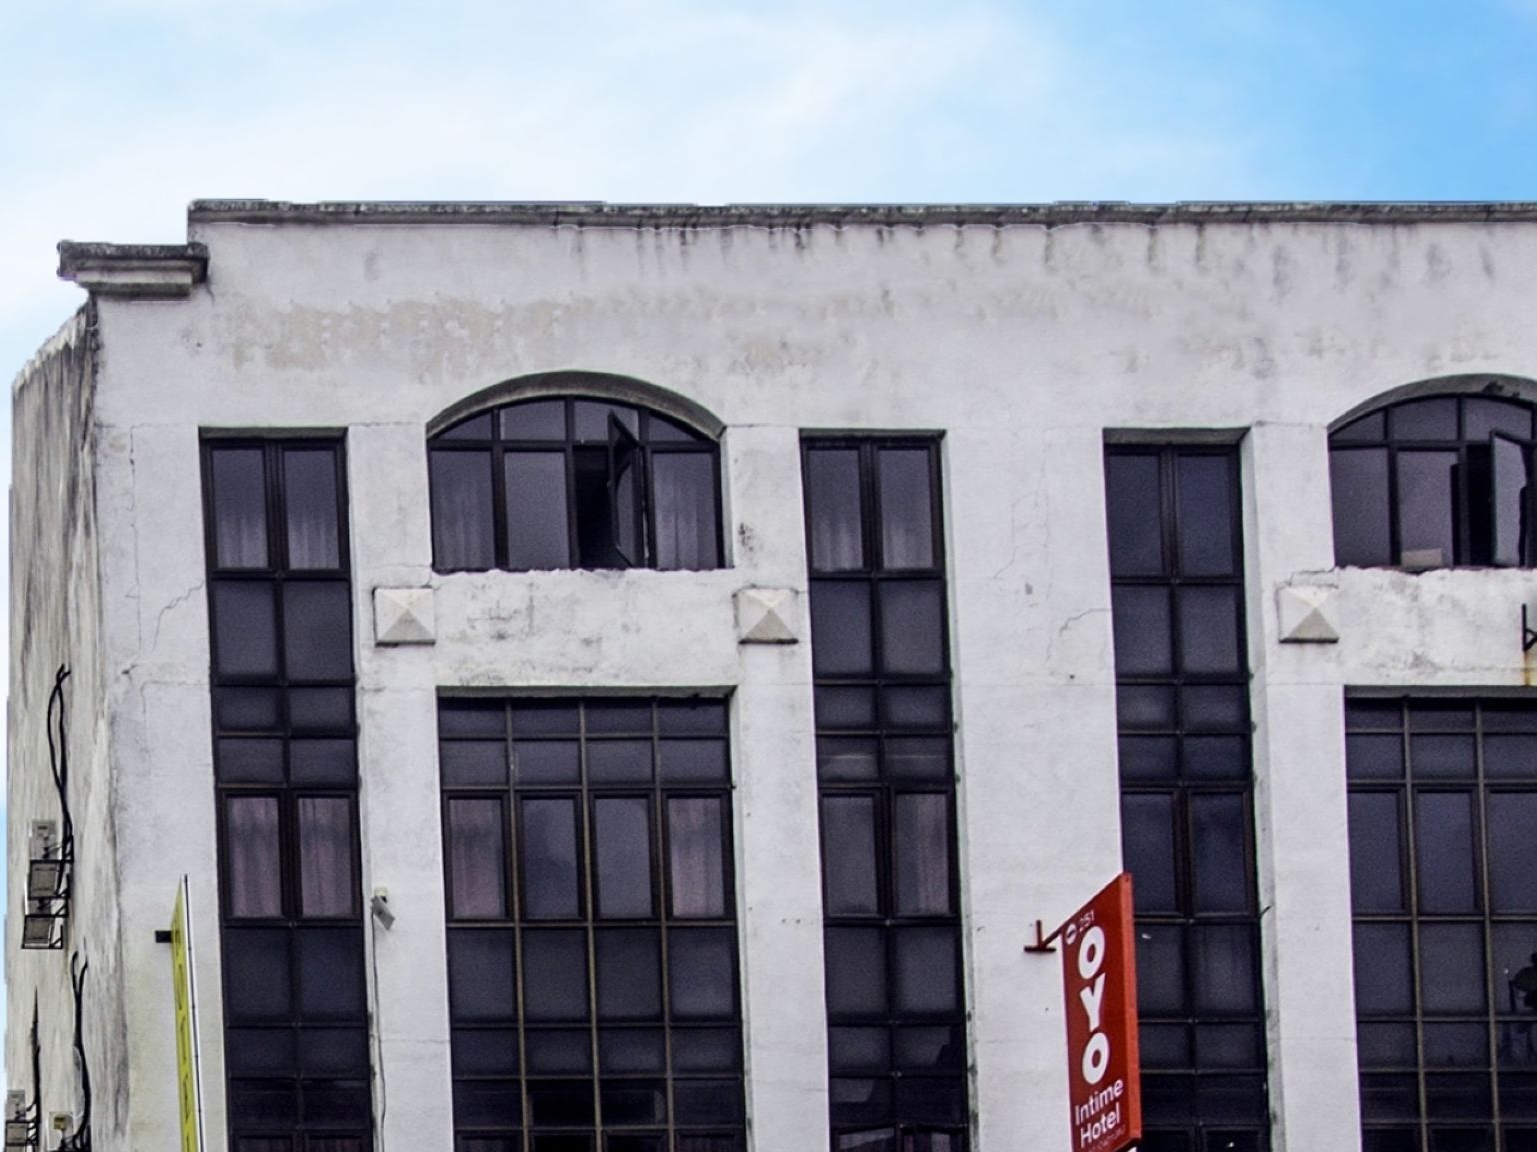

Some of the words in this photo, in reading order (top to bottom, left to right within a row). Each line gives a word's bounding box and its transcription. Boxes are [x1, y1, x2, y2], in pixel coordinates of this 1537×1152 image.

[1078, 925, 1110, 1085] OYO
[1075, 1079, 1124, 1126] Intime
[1080, 1102, 1120, 1149] Hotel
